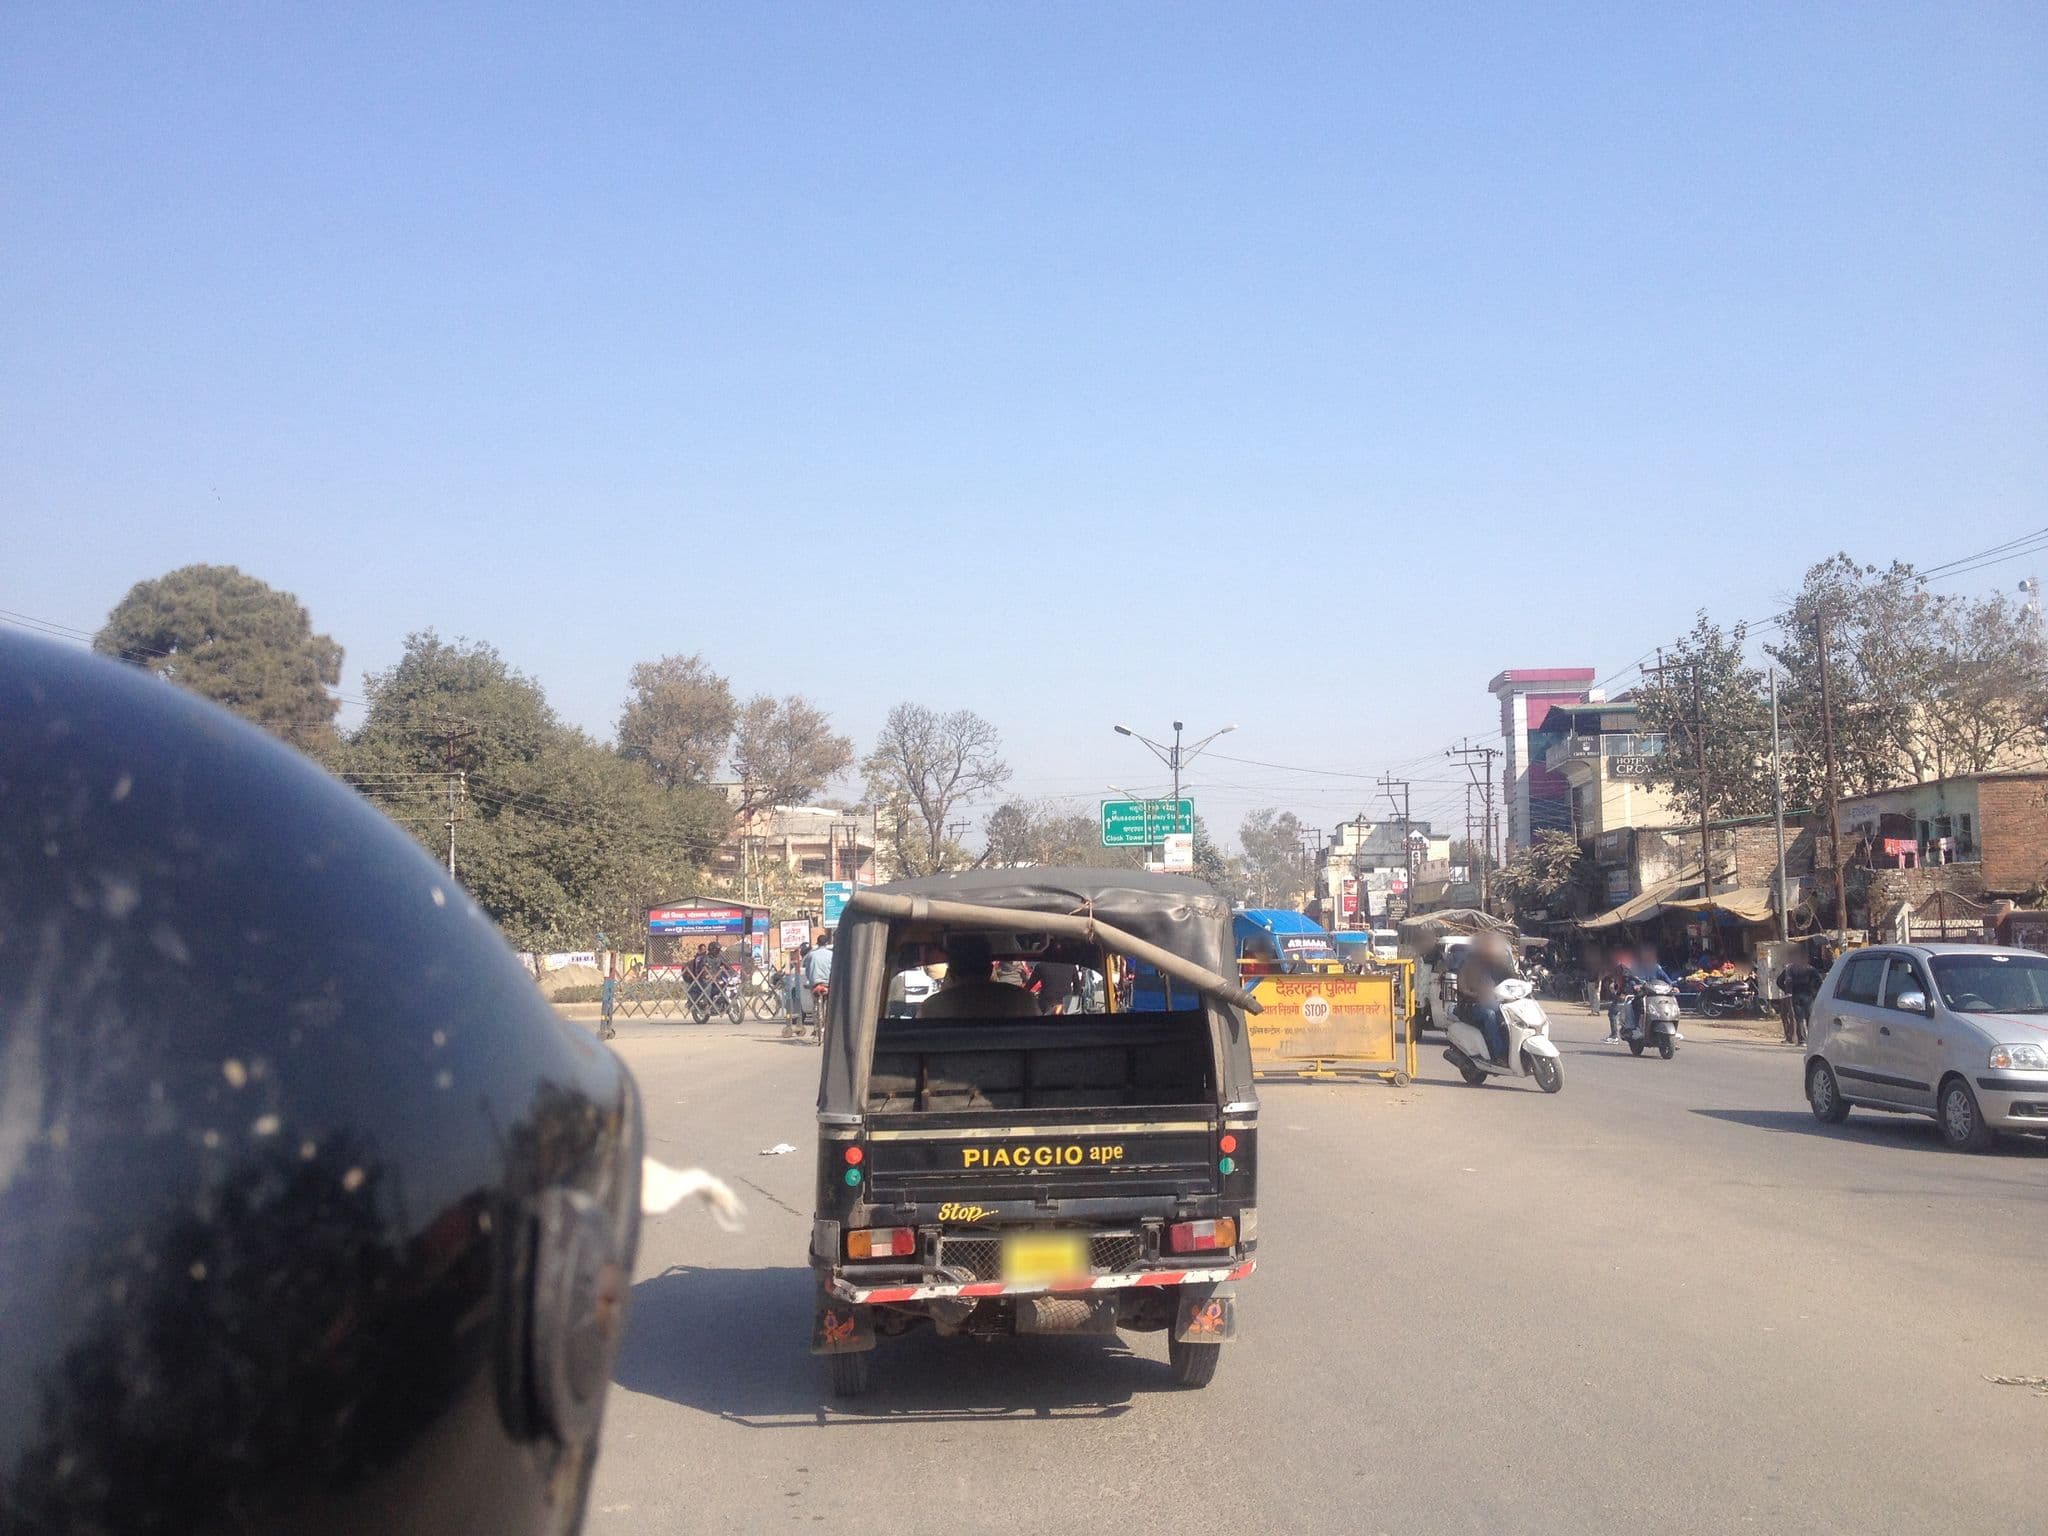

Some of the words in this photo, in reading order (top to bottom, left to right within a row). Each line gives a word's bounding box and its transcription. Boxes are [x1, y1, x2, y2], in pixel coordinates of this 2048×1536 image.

[1326, 979, 1357, 999] पुलिस
[1304, 1003, 1327, 1017] STOP
[962, 1145, 1084, 1168] PIAGGIO
[1089, 1144, 1124, 1165] ape
